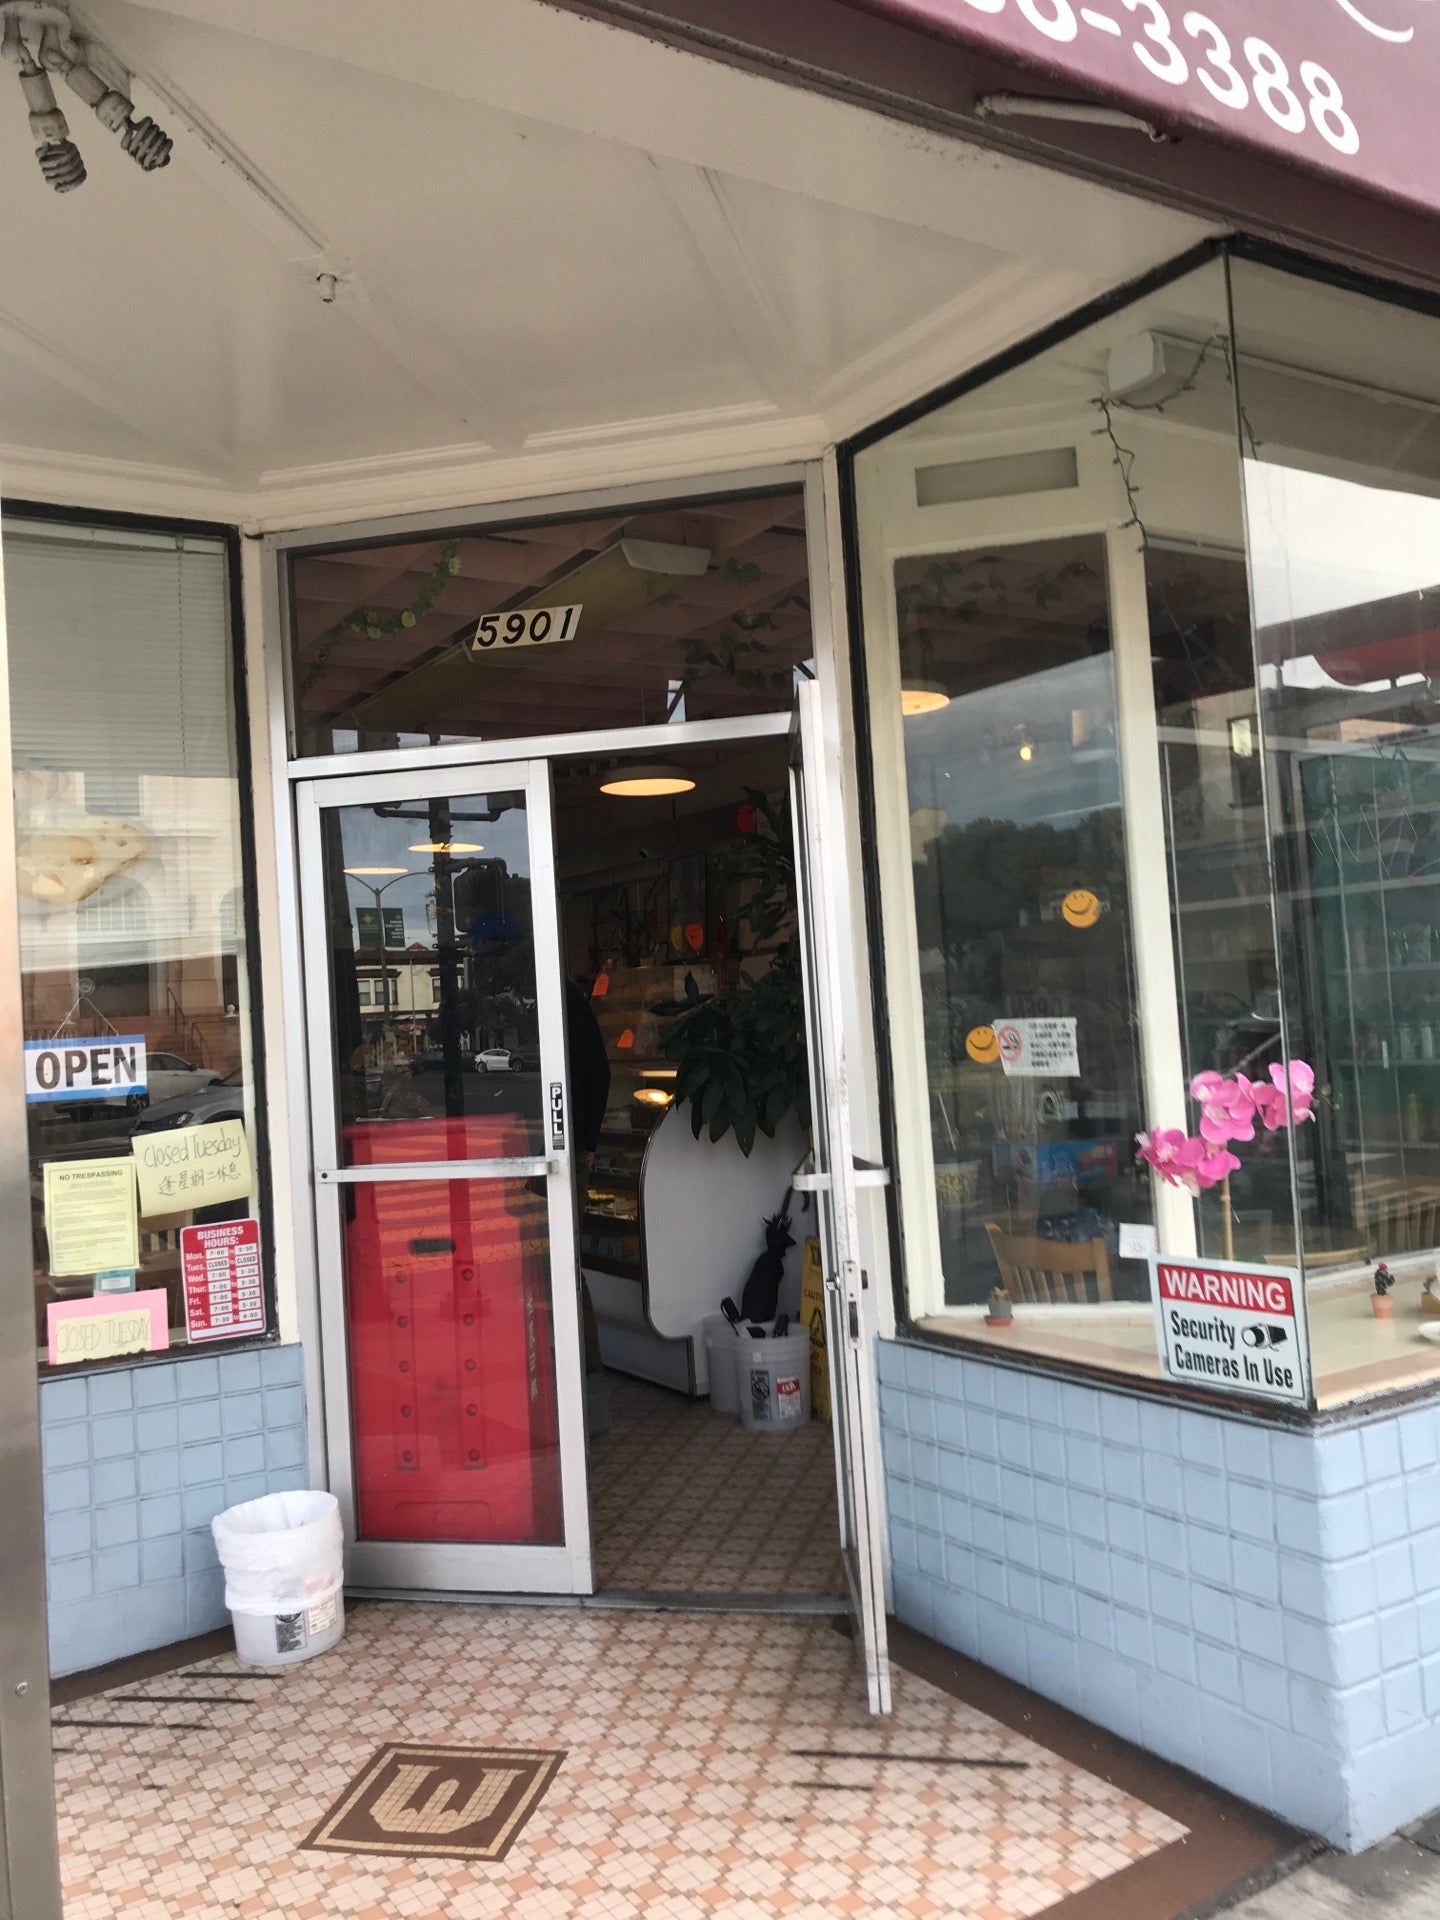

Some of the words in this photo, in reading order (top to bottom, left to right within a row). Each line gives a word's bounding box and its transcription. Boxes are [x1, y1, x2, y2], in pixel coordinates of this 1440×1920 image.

[477, 607, 573, 647] 5901
[36, 1046, 136, 1090] OPEN
[551, 1087, 563, 1134] PULL
[189, 1127, 241, 1159] Tuesday
[72, 1169, 123, 1180] TRESPASSING
[197, 1225, 244, 1240] BUSINESS
[204, 1237, 239, 1248] HOURS:
[186, 1252, 204, 1260] Mon.
[188, 1275, 206, 1283] Wed.
[188, 1286, 207, 1294] Thur.
[1163, 1268, 1287, 1312] WARNING
[104, 1317, 151, 1348] TUESDAY
[190, 1320, 207, 1328] Sun.
[1170, 1310, 1235, 1350] Security
[1174, 1343, 1239, 1379] Cameras
[1243, 1353, 1260, 1382] In
[1263, 1358, 1294, 1388] Use
